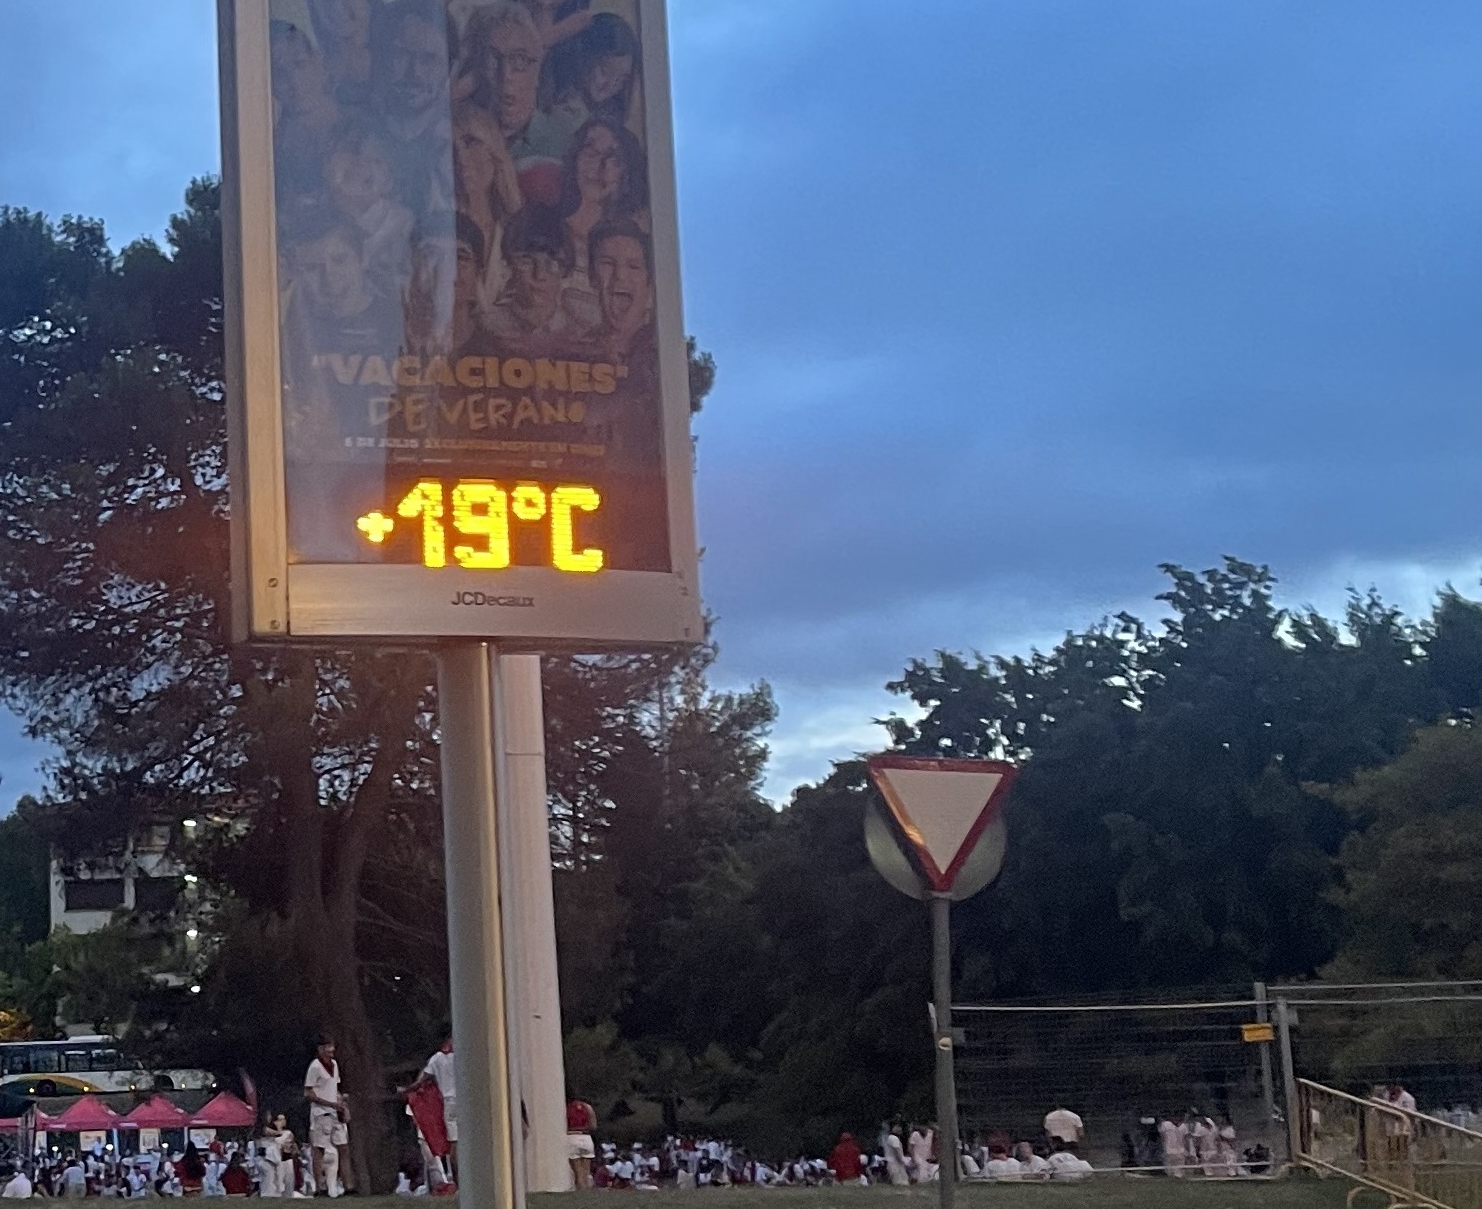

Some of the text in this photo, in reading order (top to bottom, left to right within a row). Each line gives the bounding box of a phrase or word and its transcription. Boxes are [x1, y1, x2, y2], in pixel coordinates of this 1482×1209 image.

[369, 392, 587, 432] DE VERANO
[451, 591, 535, 608] JCDecaux
